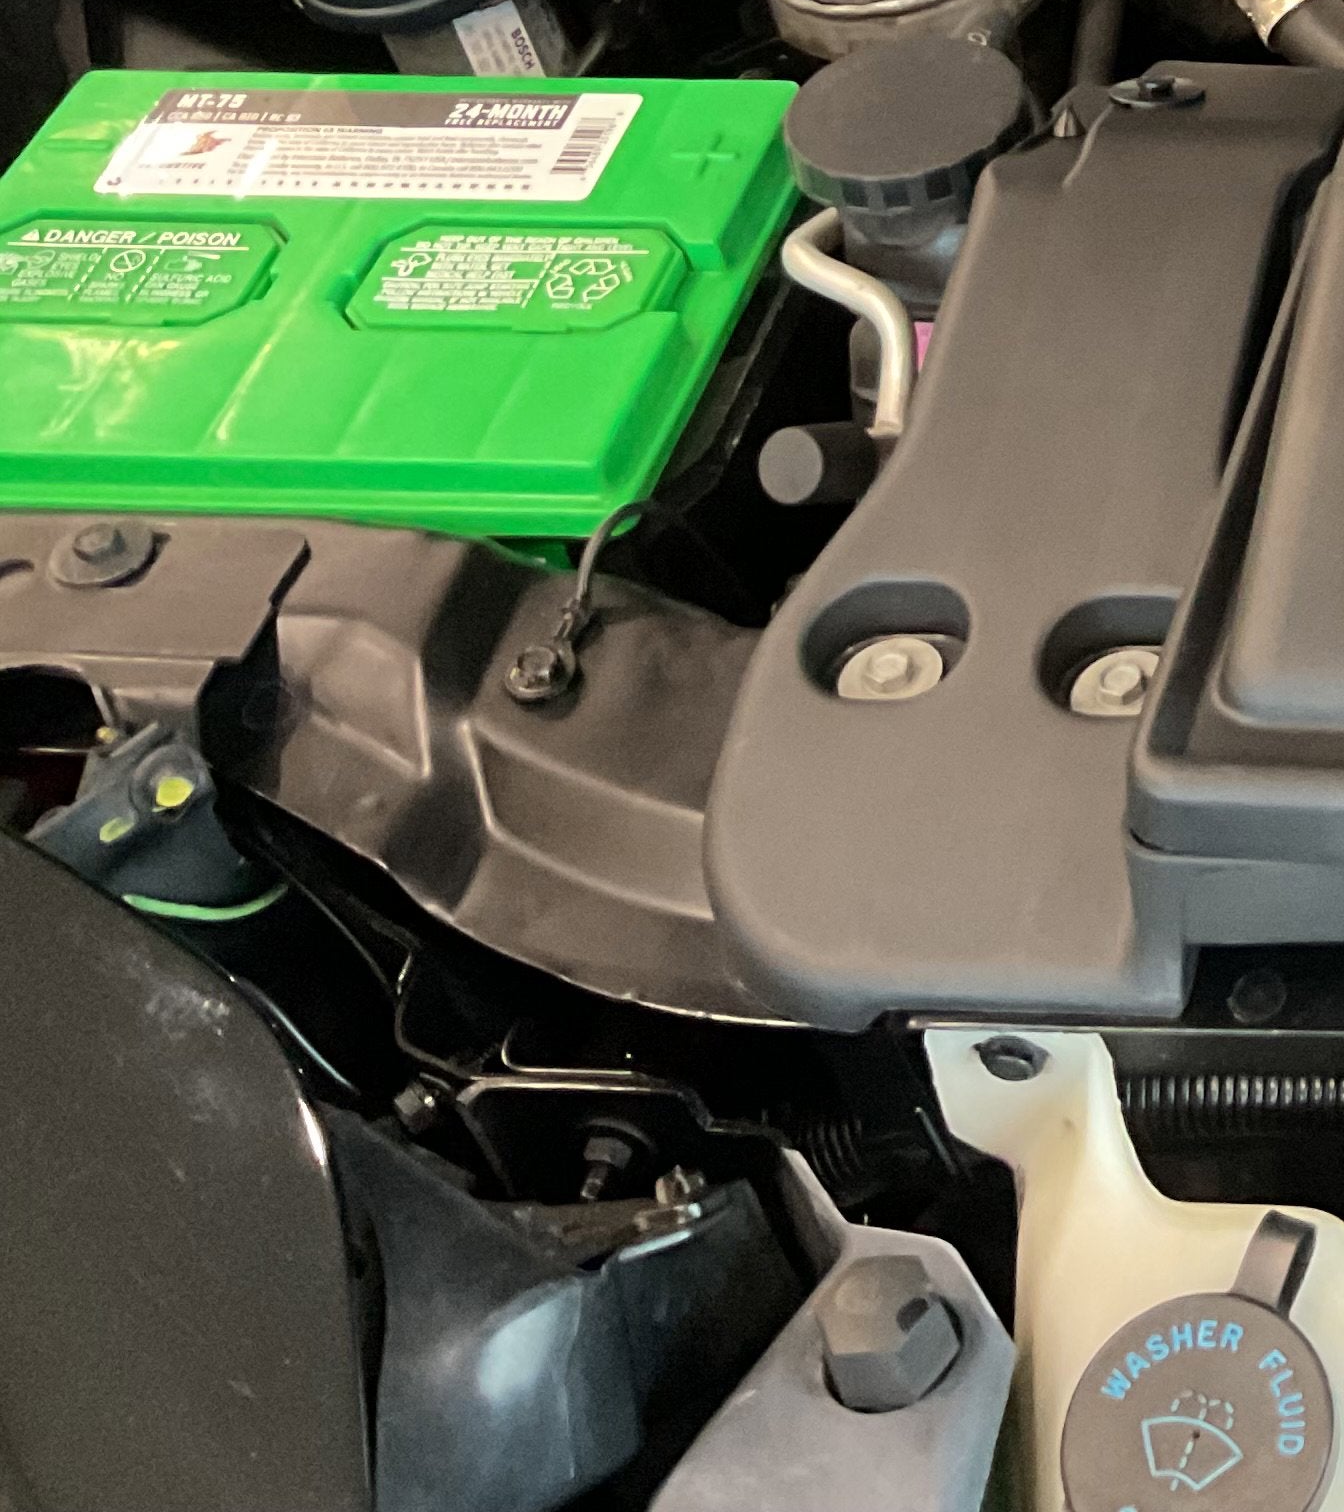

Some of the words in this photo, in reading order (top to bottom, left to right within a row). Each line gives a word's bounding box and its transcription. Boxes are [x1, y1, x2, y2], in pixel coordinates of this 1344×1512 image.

[511, 28, 536, 70] BOSCH
[176, 93, 248, 109] MT-75
[448, 102, 569, 121] 24-MONTH
[444, 119, 473, 127] FREE
[475, 119, 561, 128] REPLACEMENT
[43, 229, 137, 244] DANGER
[157, 231, 241, 246] POISON
[105, 272, 125, 282] NO
[204, 274, 233, 284] ACID
[1100, 1319, 1244, 1400] WASHER
[1258, 1349, 1305, 1456] FLUID
